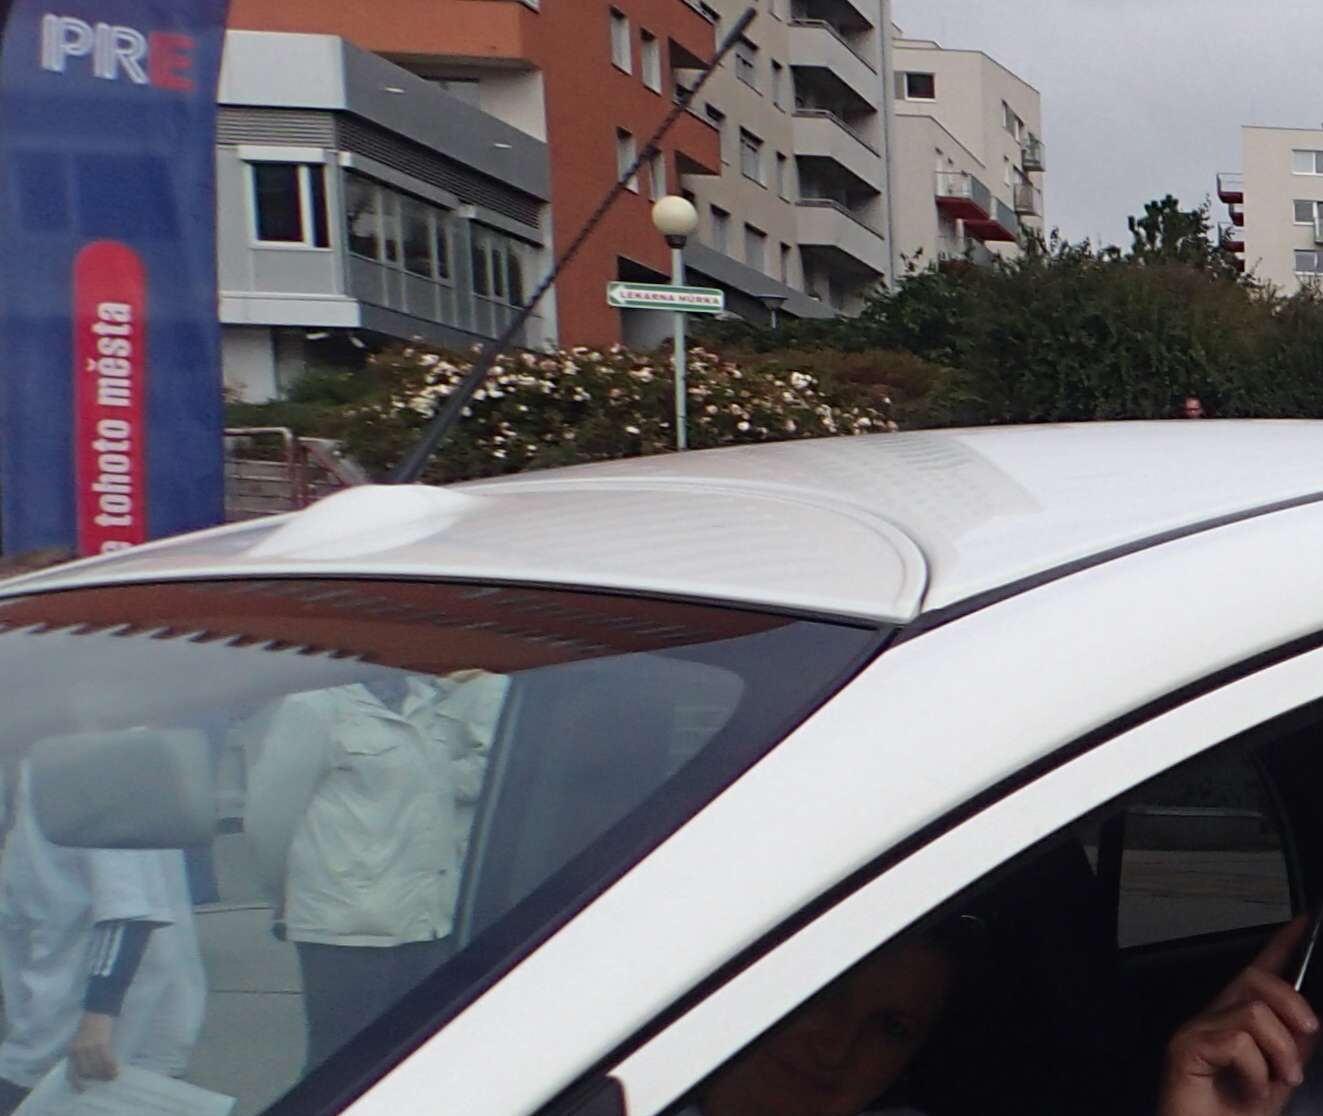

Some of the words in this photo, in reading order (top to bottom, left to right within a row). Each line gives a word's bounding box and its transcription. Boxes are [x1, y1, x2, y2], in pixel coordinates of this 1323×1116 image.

[40, 13, 197, 91] PRE
[86, 302, 132, 406] města
[94, 418, 132, 527] tohoto
